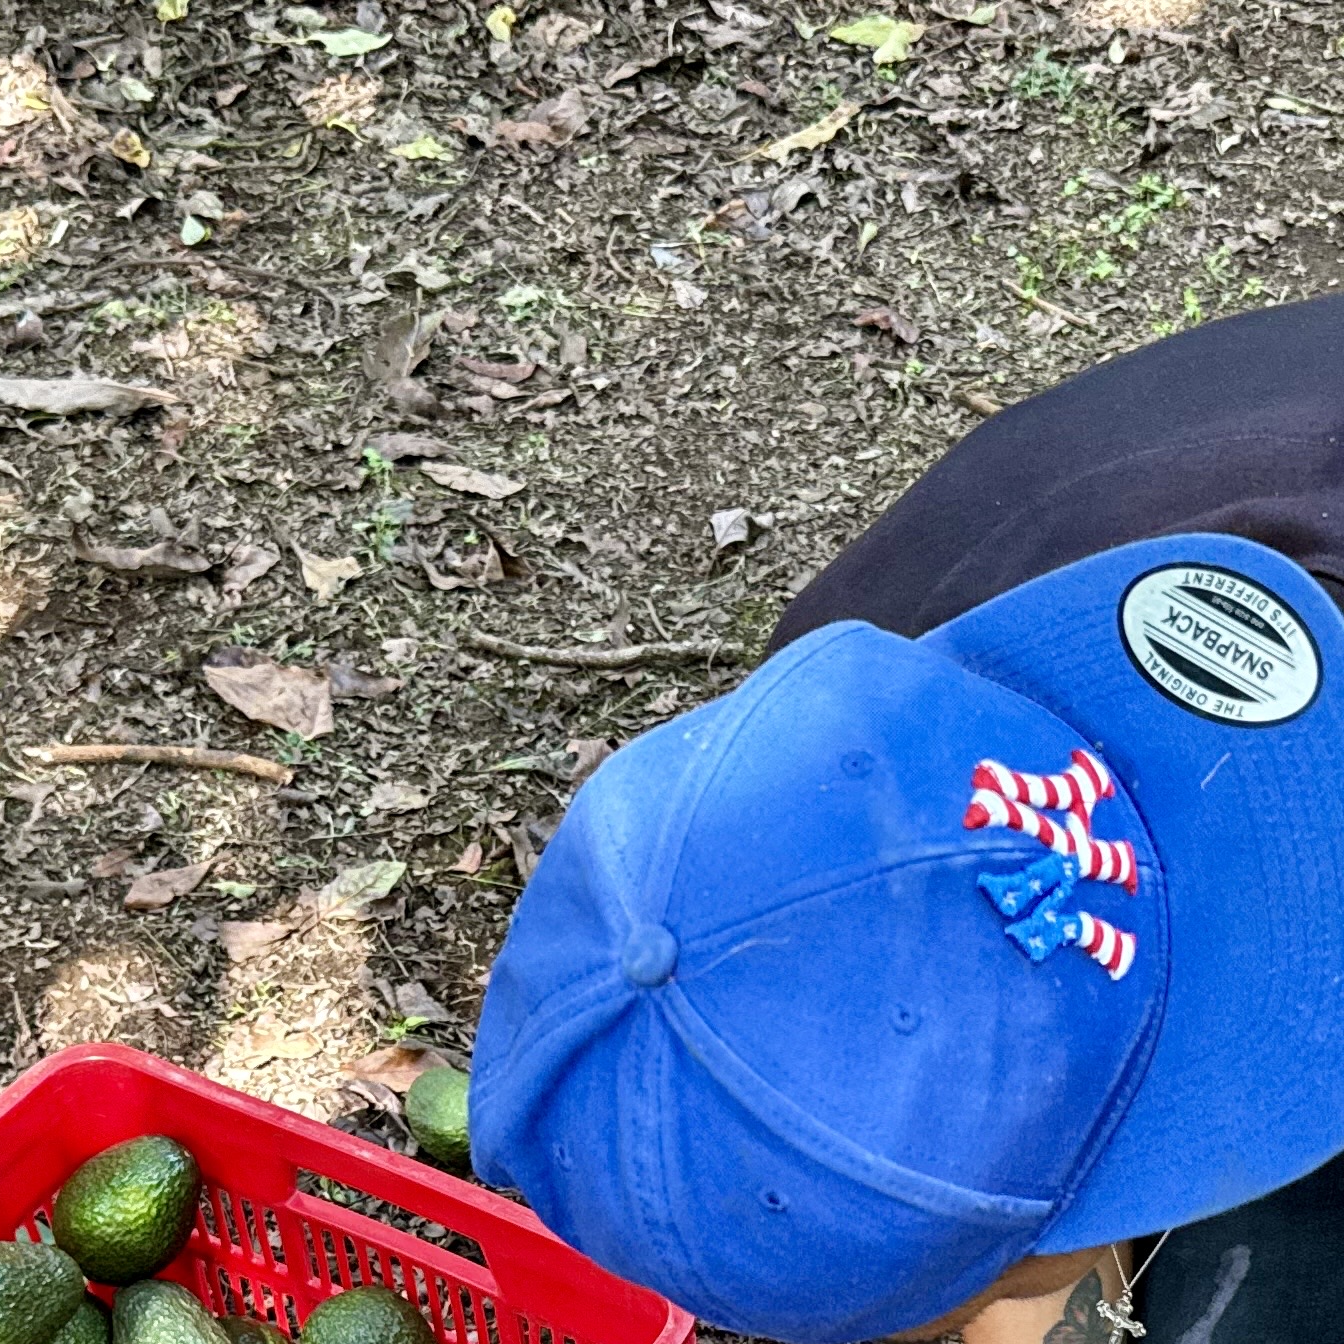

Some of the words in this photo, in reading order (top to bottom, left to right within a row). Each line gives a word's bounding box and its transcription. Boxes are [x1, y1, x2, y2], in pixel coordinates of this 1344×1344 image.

[1182, 572, 1269, 612] DIFFERENT
[1160, 605, 1274, 680] SNAPBACK
[1269, 608, 1297, 638] IT'S
[1144, 651, 1208, 705] ORIGINAL
[1213, 700, 1244, 717] THE
